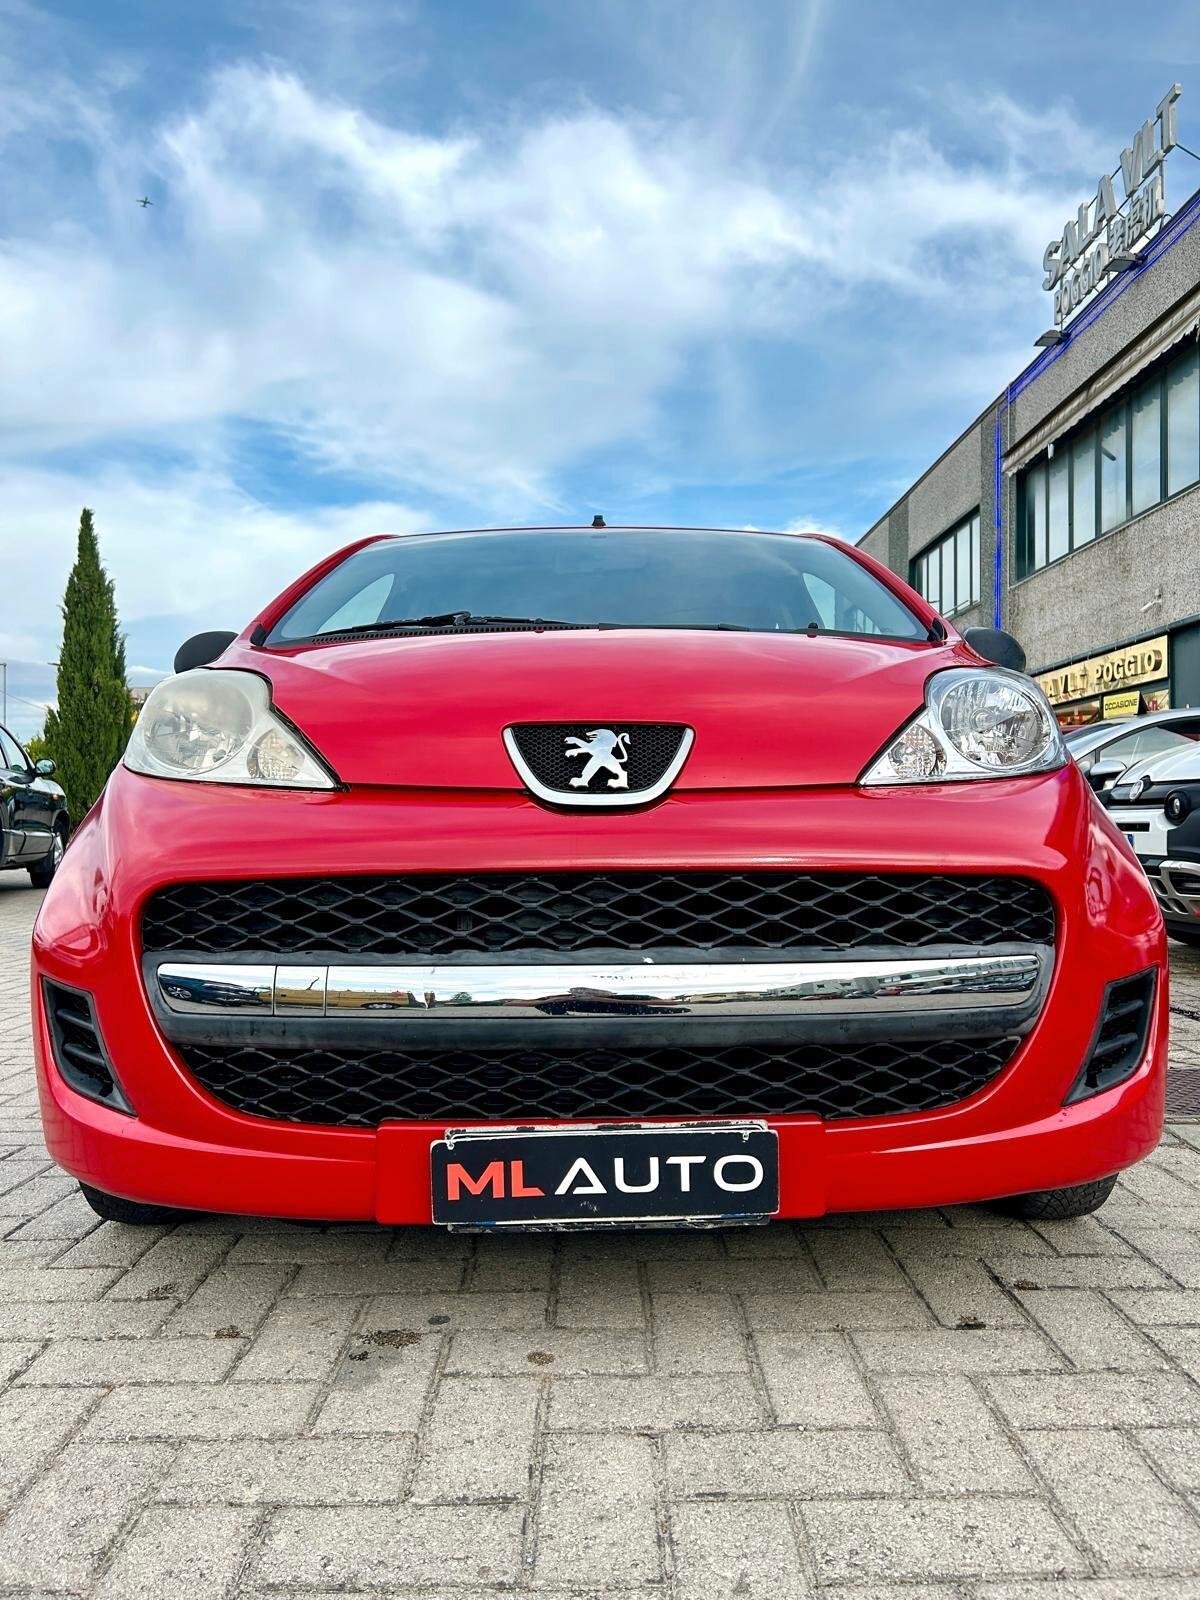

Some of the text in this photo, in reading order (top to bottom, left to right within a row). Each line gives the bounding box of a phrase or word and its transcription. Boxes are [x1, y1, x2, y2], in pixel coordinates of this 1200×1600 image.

[1042, 83, 1181, 291] SALA VLT
[1054, 243, 1109, 325] POGGIO
[1094, 649, 1162, 685] POGGIO
[1104, 698, 1137, 711] OCCASIONE
[447, 1155, 764, 1200] ML AUTO
